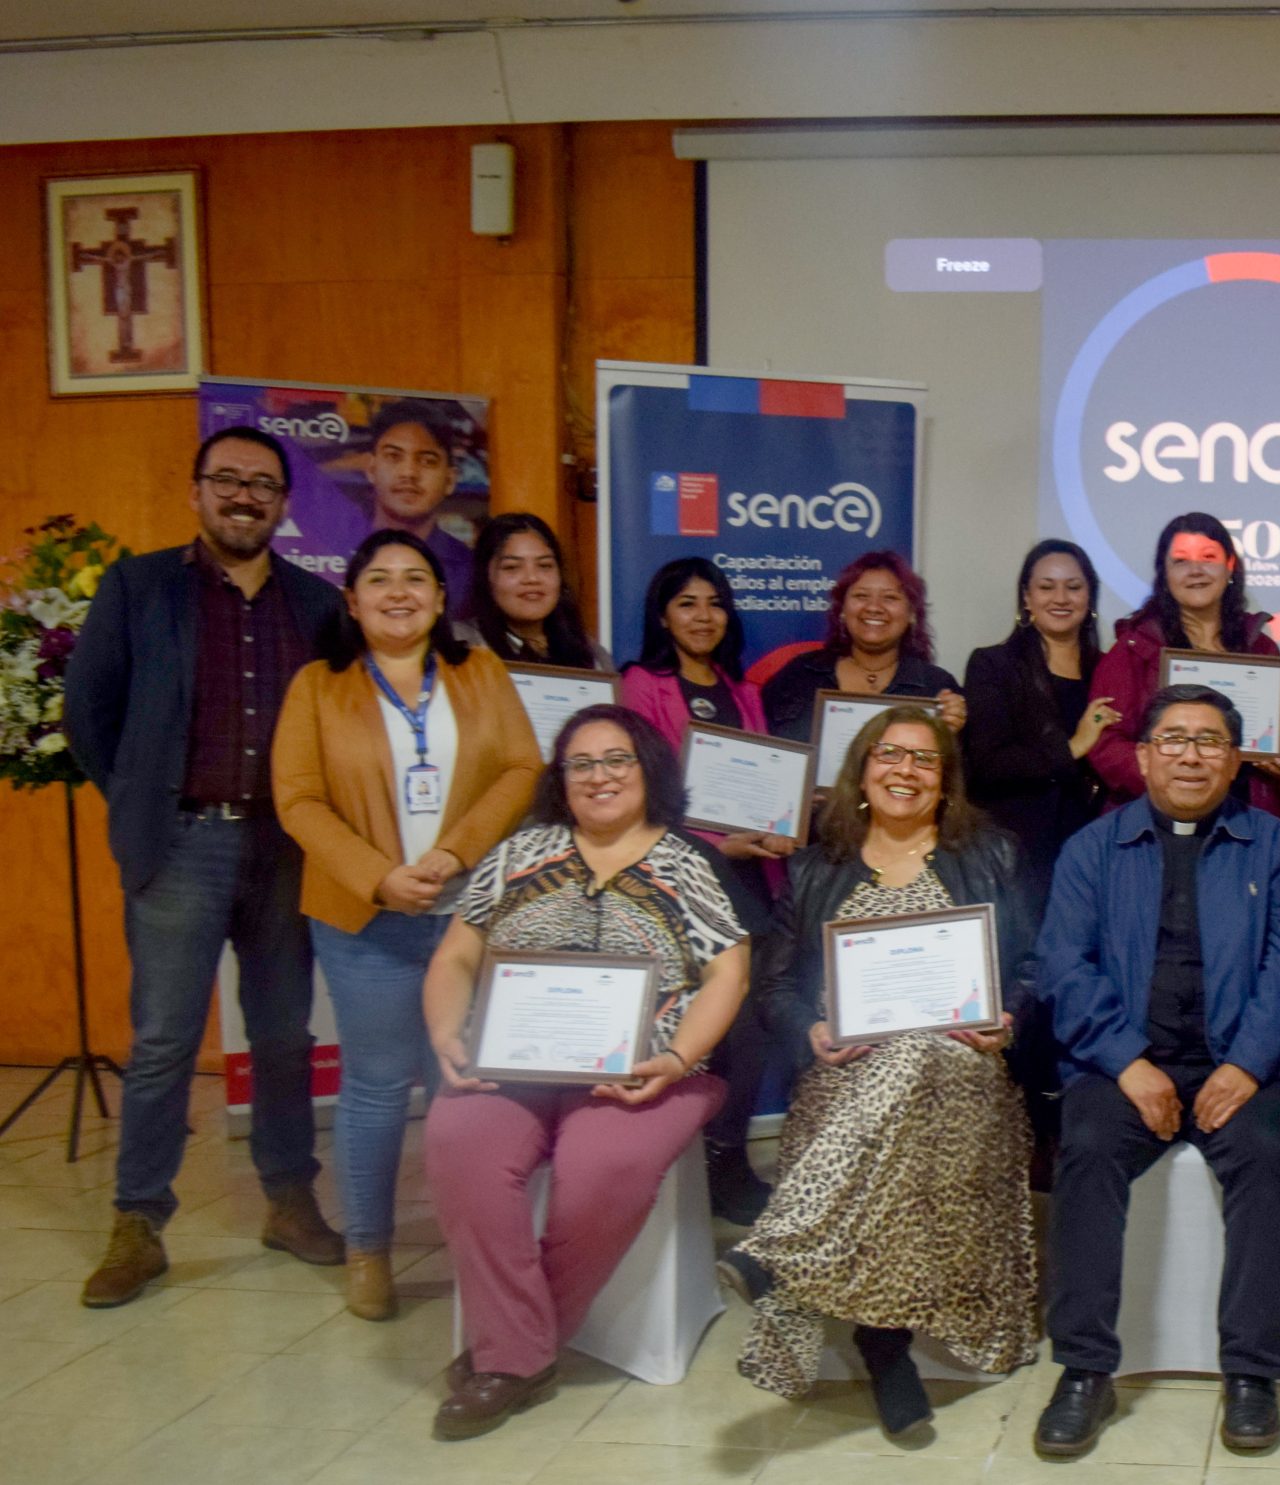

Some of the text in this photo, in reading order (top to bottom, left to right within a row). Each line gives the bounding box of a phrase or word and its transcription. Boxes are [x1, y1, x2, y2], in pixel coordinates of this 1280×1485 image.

[936, 258, 991, 272] Freeze
[258, 412, 350, 444] sence
[727, 482, 882, 538] sence
[282, 547, 348, 574] iere
[712, 552, 822, 572] Capacitación
[726, 574, 838, 594] dios al emple
[733, 595, 833, 611] ediación lab
